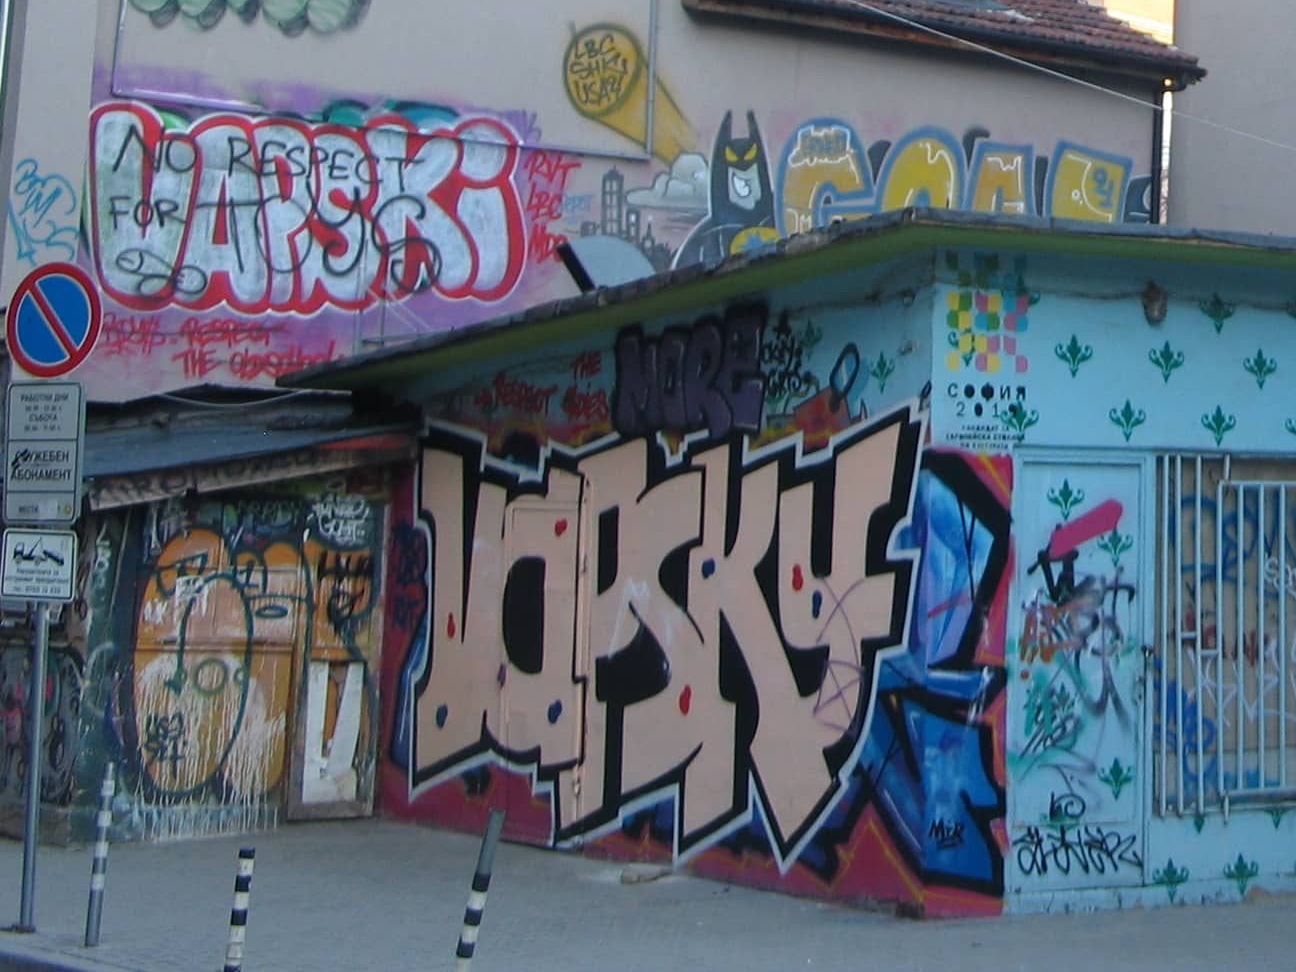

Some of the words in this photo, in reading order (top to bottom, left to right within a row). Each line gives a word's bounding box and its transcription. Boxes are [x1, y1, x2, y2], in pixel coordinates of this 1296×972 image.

[110, 126, 197, 175] NO
[226, 135, 426, 182] RESPECT
[109, 196, 188, 230] FOR
[947, 381, 1026, 402] СОФИЯ
